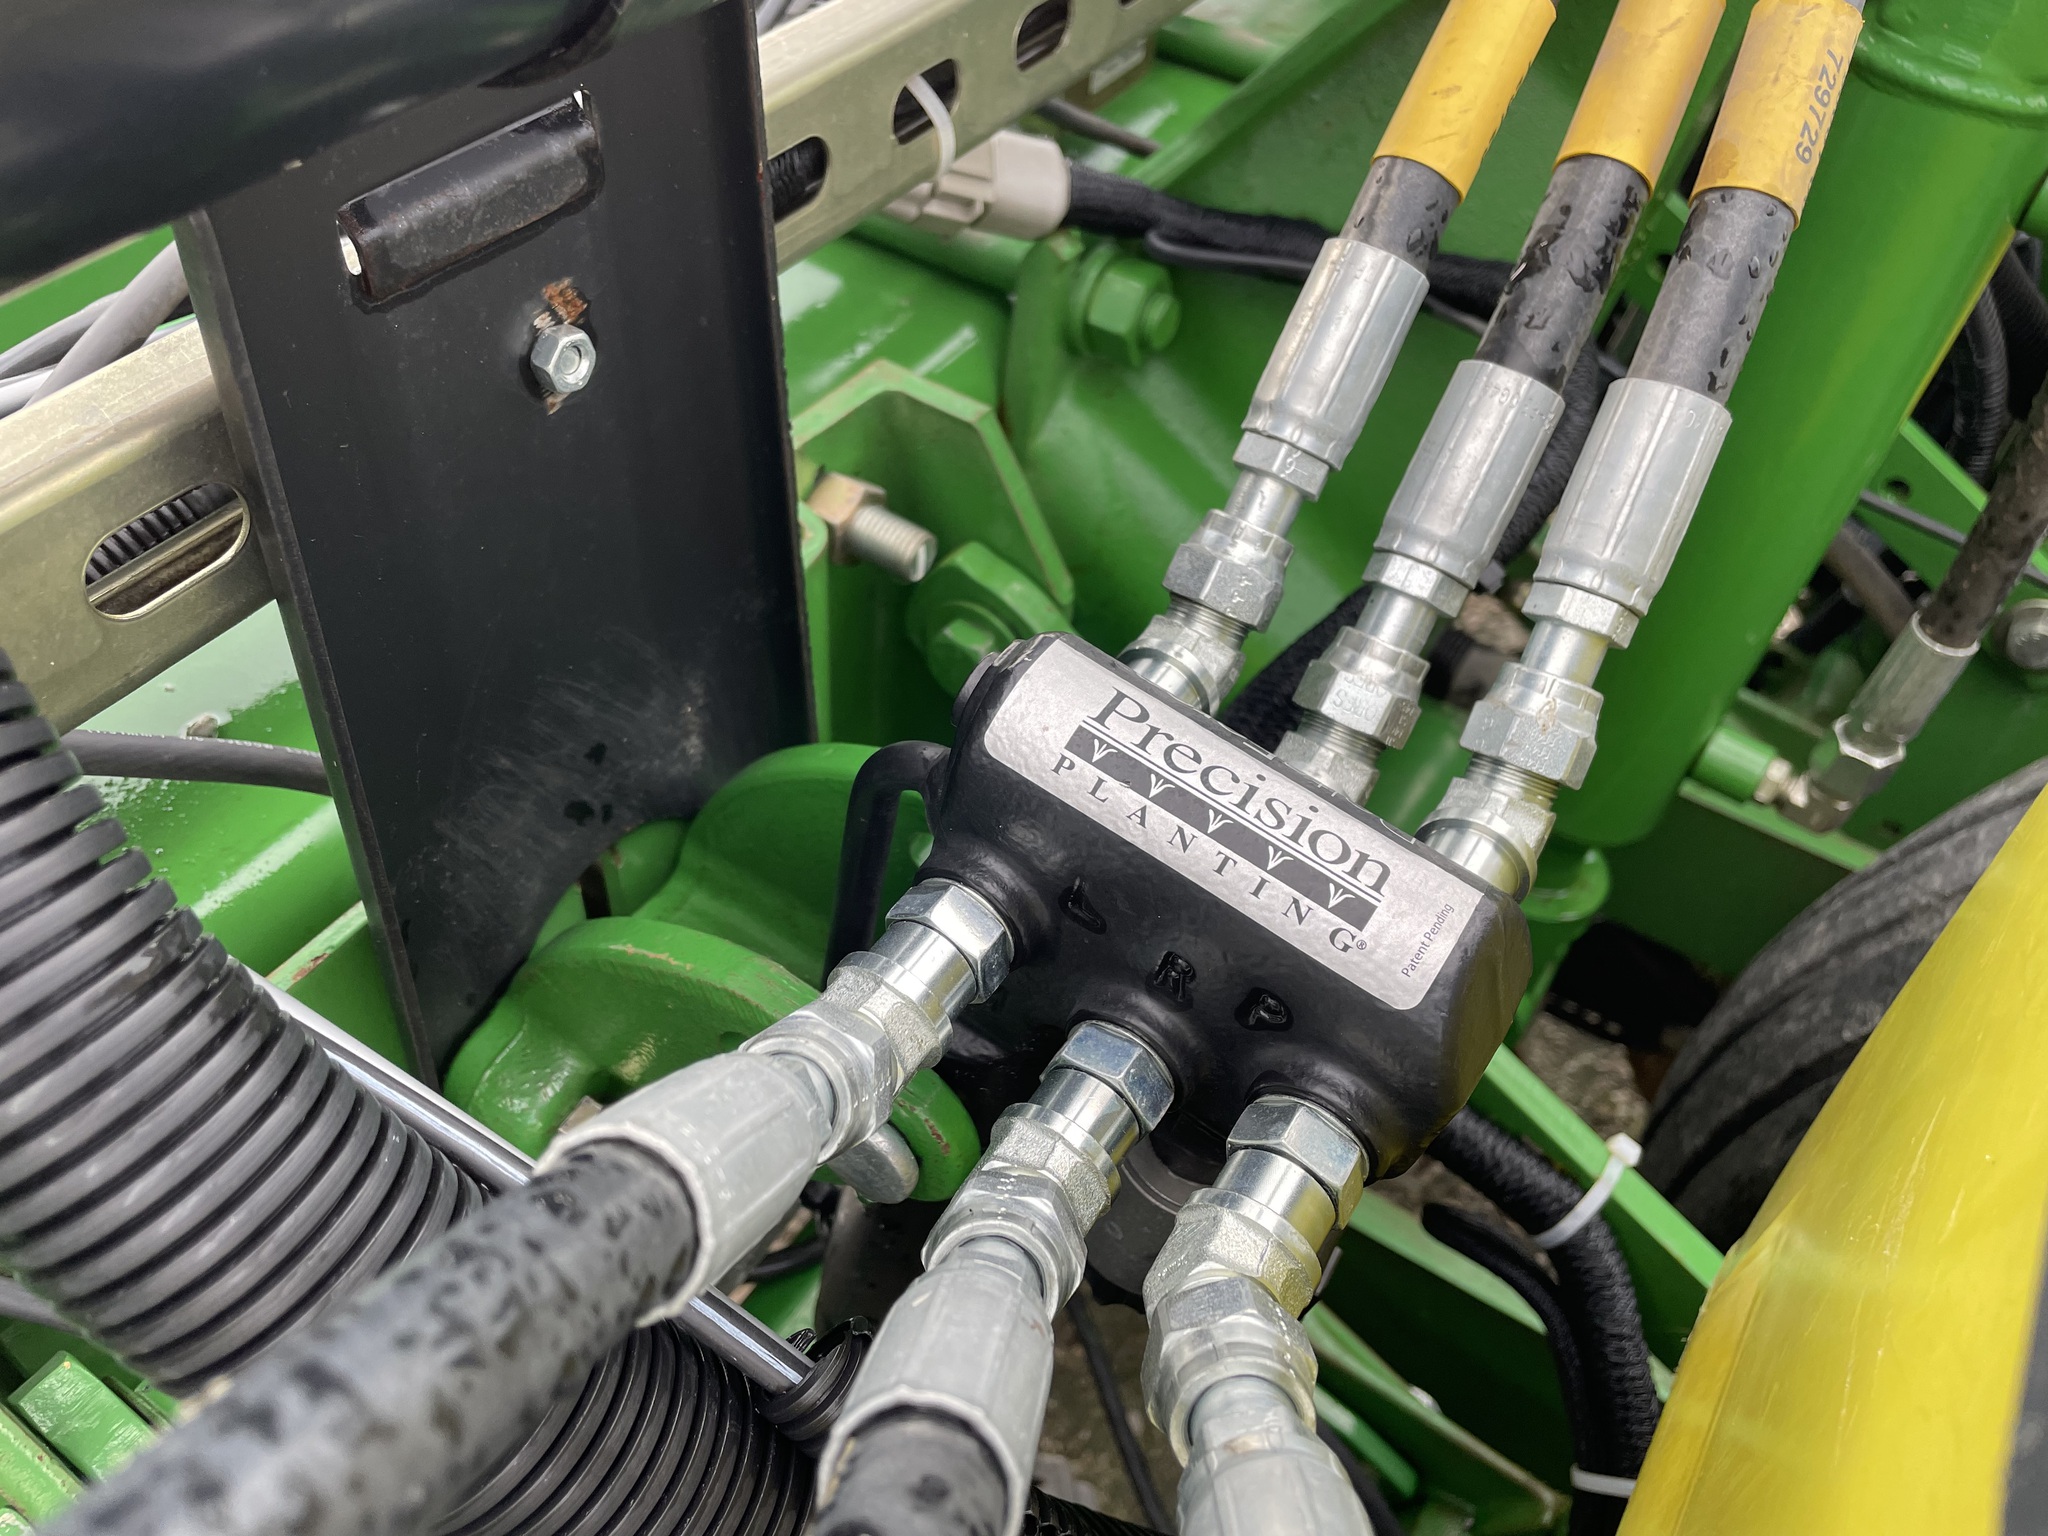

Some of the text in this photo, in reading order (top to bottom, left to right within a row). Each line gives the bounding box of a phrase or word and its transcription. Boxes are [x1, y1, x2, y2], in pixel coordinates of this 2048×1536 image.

[1795, 48, 1844, 165] 729729
[1087, 685, 1391, 898] Precision
[1153, 950, 1197, 1003] R
[1401, 903, 1455, 978] Patent Pending
